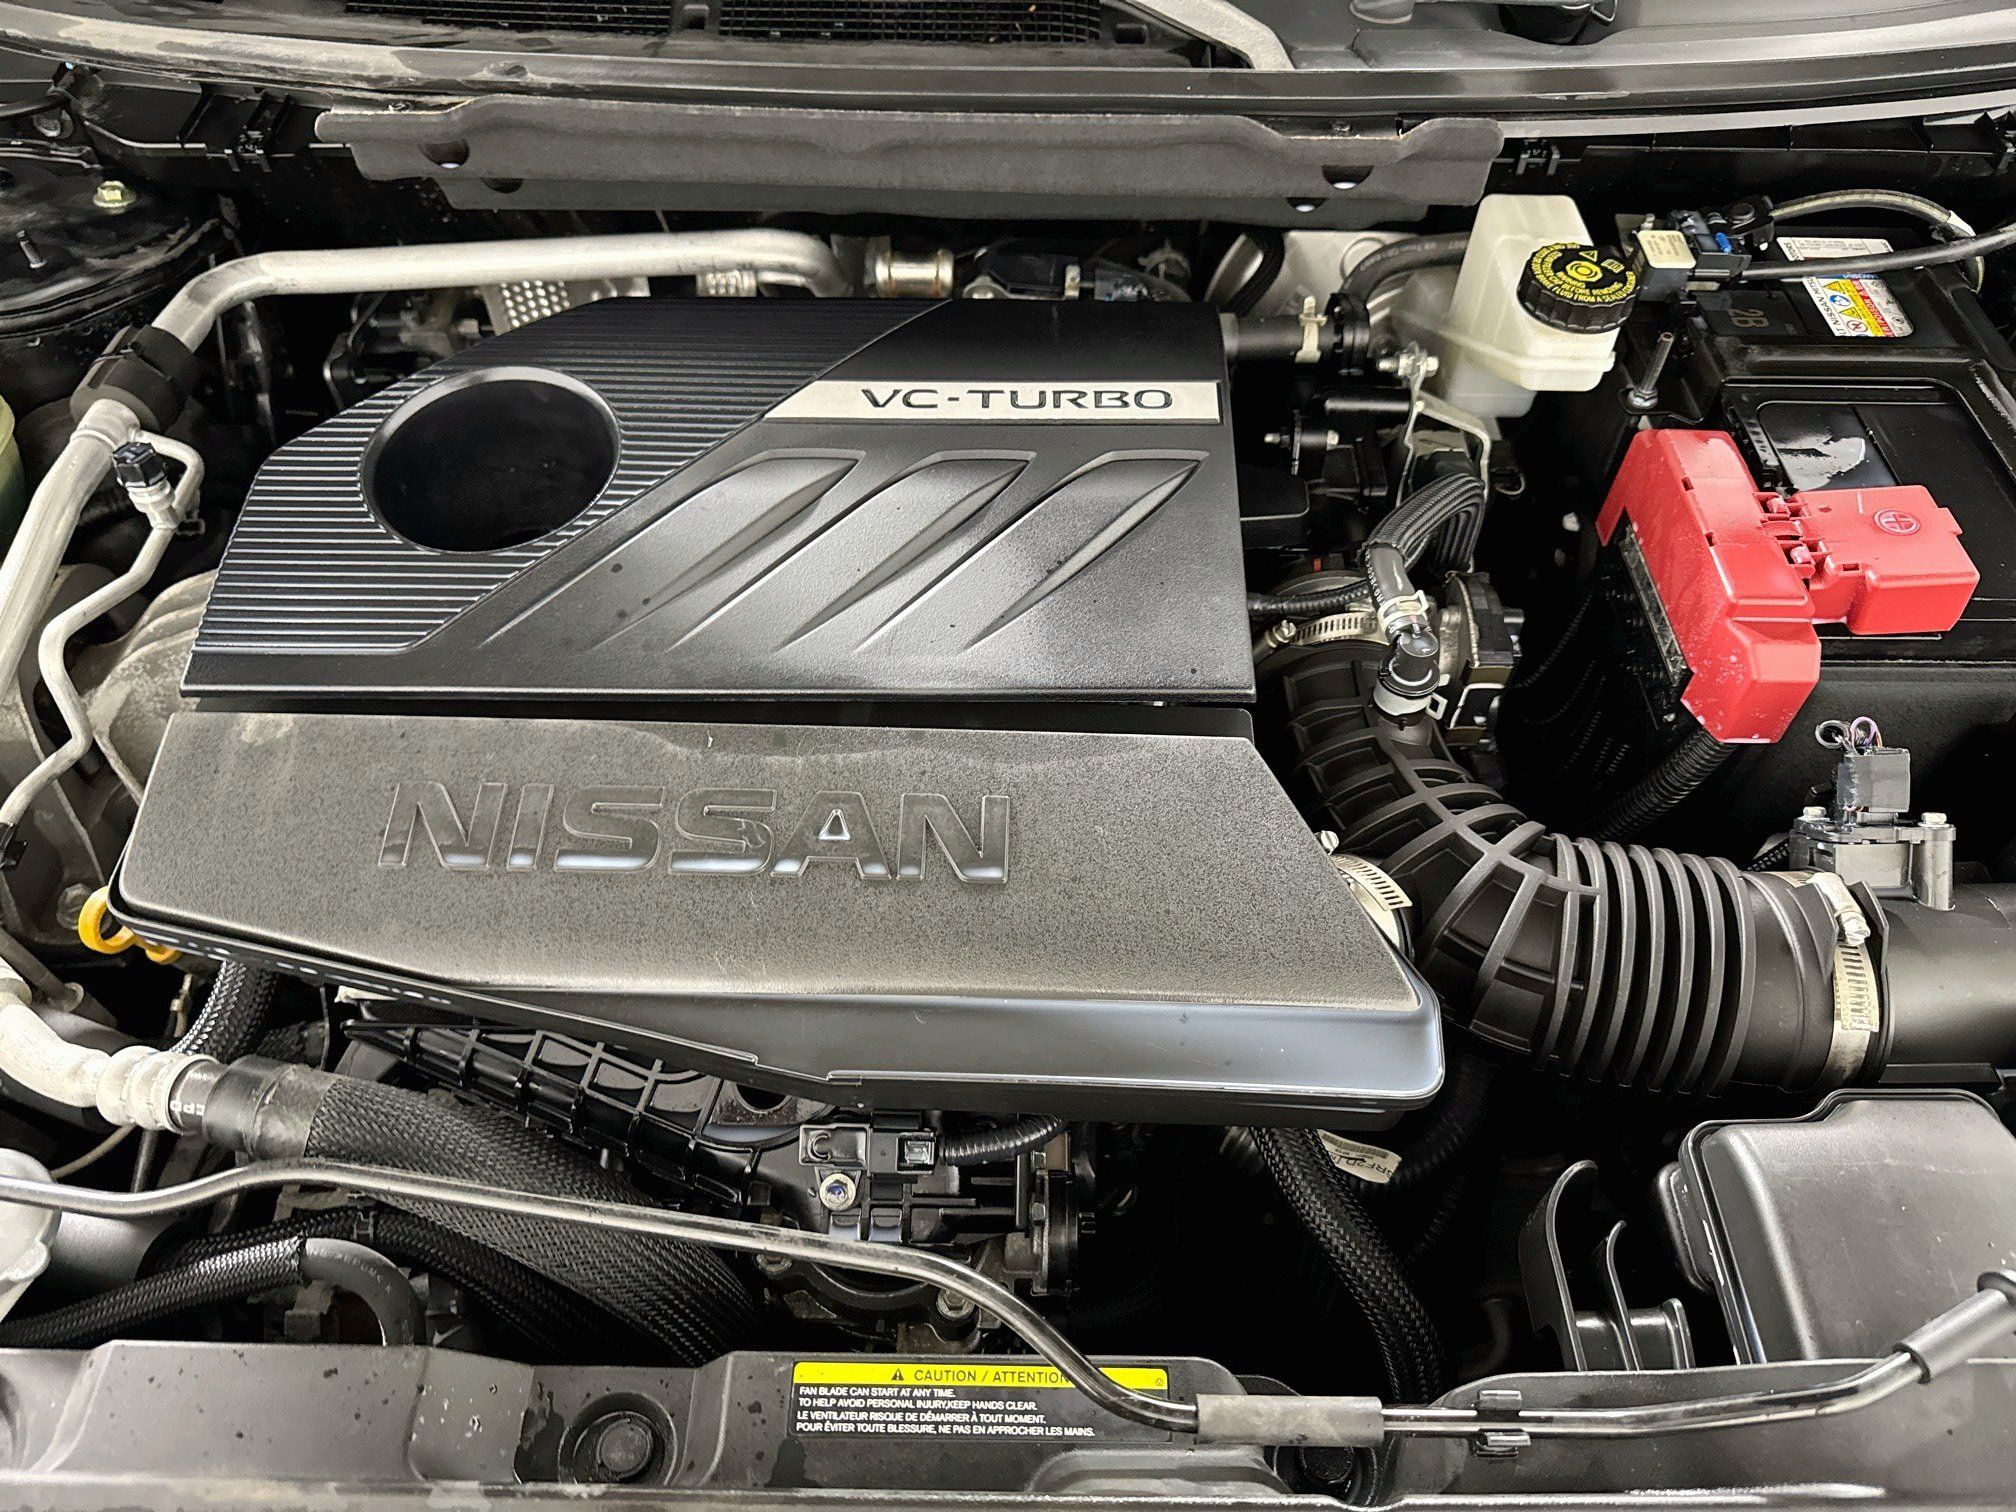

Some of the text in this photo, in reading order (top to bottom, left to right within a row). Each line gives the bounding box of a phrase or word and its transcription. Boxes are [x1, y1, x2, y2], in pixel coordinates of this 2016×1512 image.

[1574, 293, 1596, 303] FROM
[1817, 295, 1839, 326] NISSAN
[861, 389, 1173, 409] VC-TURBO
[378, 780, 1010, 884] NISSAN
[914, 1369, 977, 1382] CAUTION
[799, 1386, 956, 1398] FAN BLADE CAN START AT ANY TIME.
[799, 1397, 811, 1407] TO
[812, 1397, 836, 1407] HELP
[837, 1398, 865, 1407] AVOID
[866, 1399, 916, 1409] PERSONAL
[972, 1401, 1004, 1411] HANDS
[1005, 1401, 1037, 1411] CLEAR.
[796, 1410, 1046, 1424] LE VENTILATEUR RISQUE DE DÉMARRER À TOUT MOMENT.
[796, 1420, 1096, 1437] POUR ÉVITER TOUTE BLESSURE, NE PAS EN APPROCHER LES MAINS.
